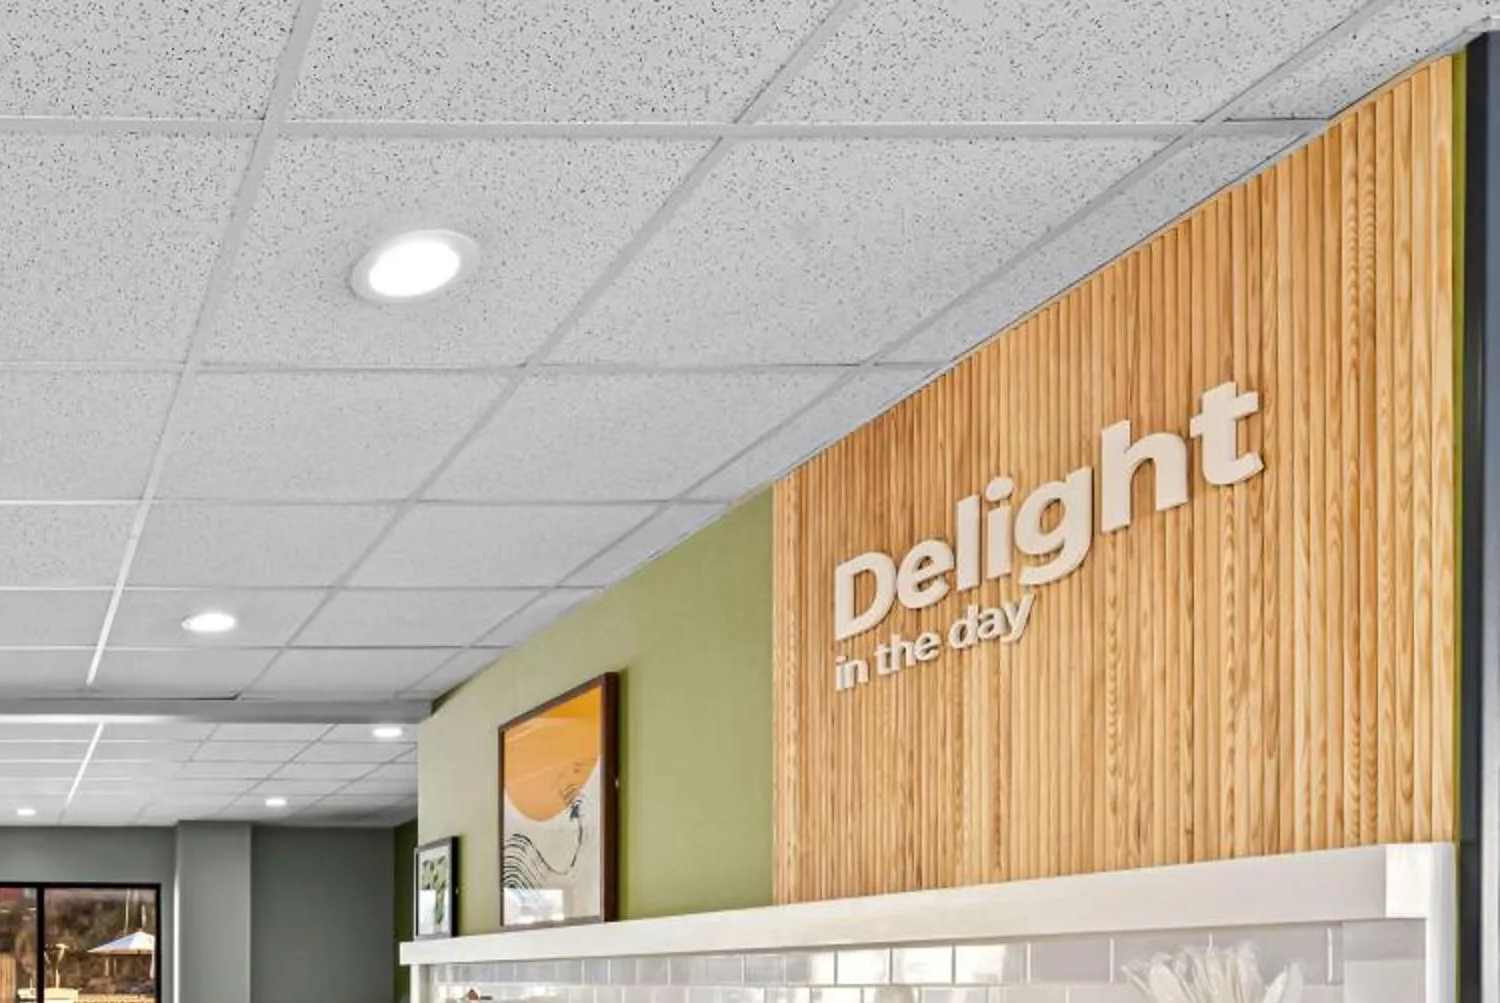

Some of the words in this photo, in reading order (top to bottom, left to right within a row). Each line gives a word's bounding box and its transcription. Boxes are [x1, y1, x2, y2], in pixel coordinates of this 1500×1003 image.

[834, 381, 1264, 641] Delight
[835, 655, 869, 691] in
[874, 632, 941, 676] the
[948, 593, 1035, 650] day
